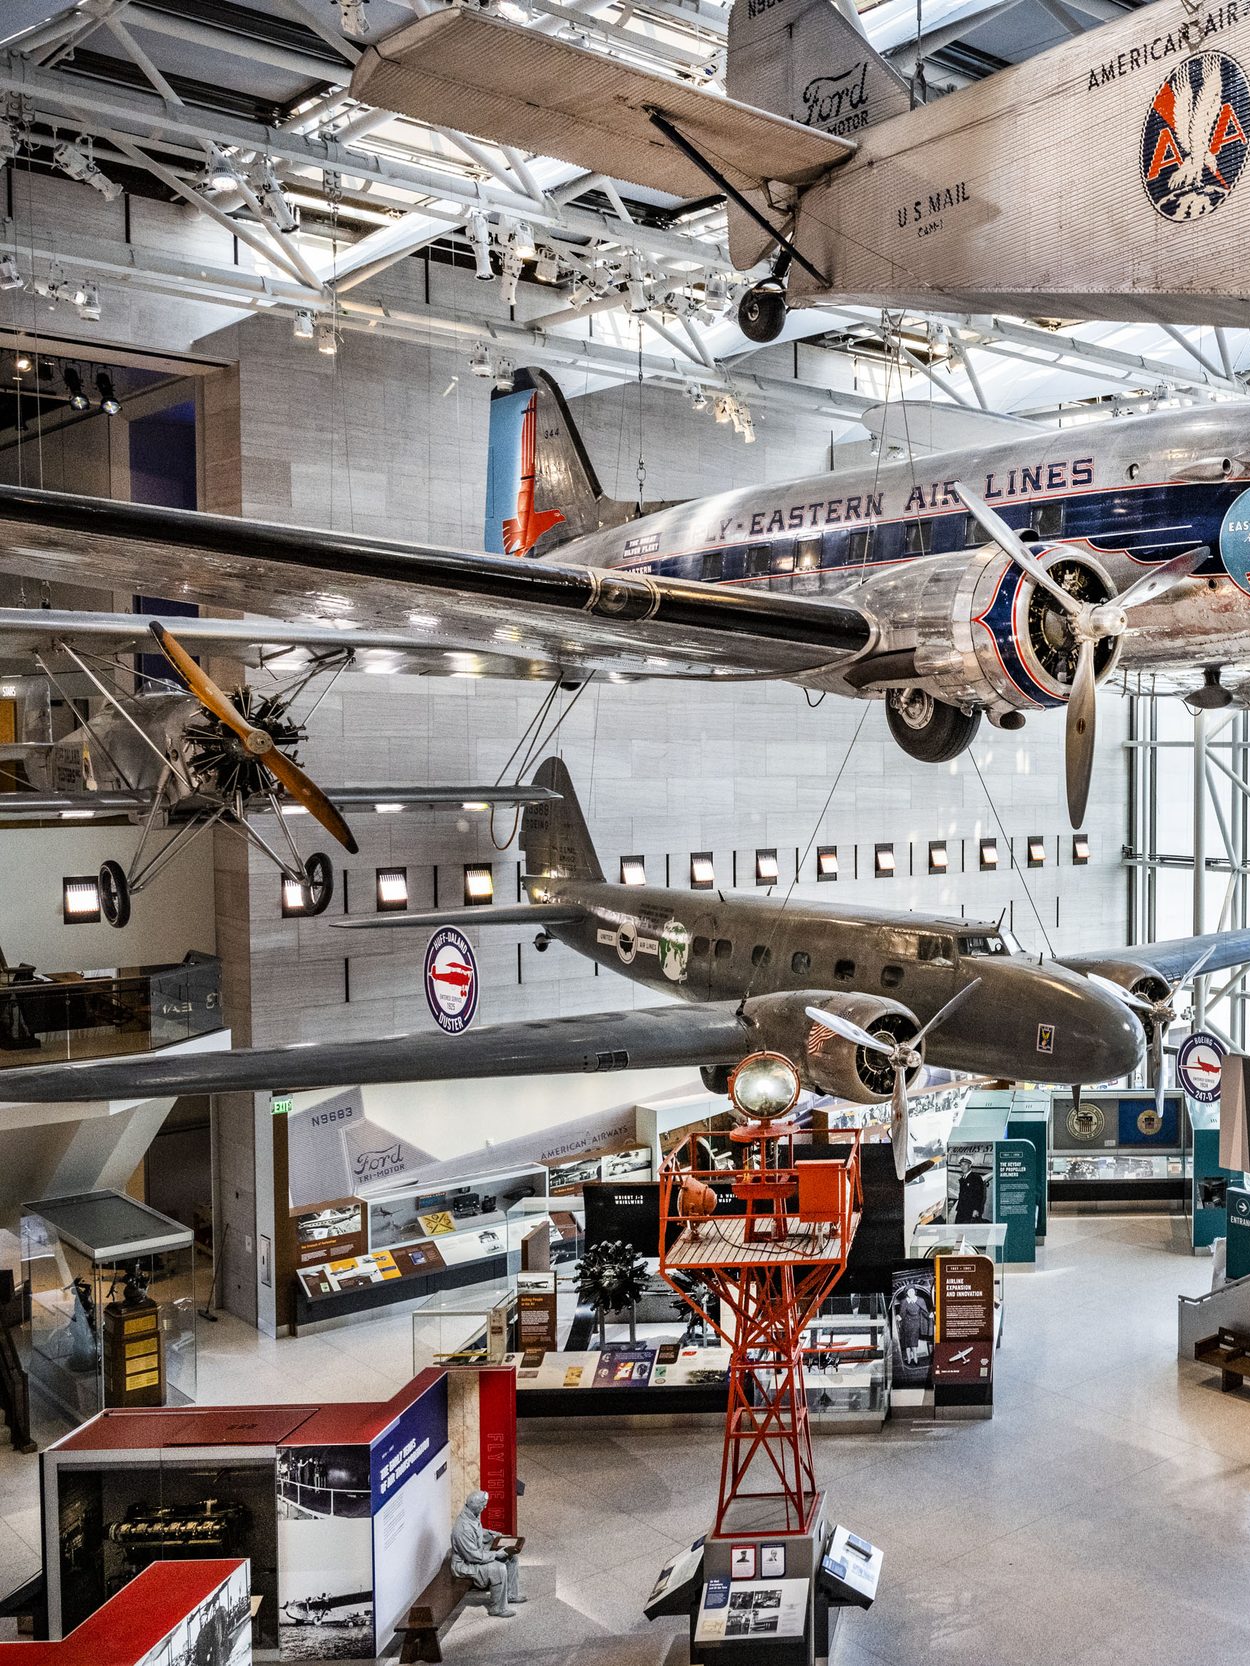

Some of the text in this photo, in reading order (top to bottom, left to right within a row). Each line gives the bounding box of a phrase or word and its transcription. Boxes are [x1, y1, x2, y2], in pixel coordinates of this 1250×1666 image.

[790, 62, 868, 126] Ford
[928, 182, 970, 215] MAIL
[905, 479, 960, 512] AIR
[984, 456, 1095, 500] LINES
[642, 543, 659, 553] FLEET
[433, 932, 467, 954] HUFF-DALAND
[438, 1012, 463, 1030] DUSTER
[1194, 1036, 1213, 1046] BOEING
[1195, 1091, 1212, 1101] 247-D
[311, 1107, 353, 1127] N9683
[541, 1125, 628, 1160] AMERICAN AIRWAYS
[353, 1143, 404, 1175] Ford
[358, 1163, 405, 1183] TRI-MOTOR
[488, 1433, 504, 1530] FLY THE MA
